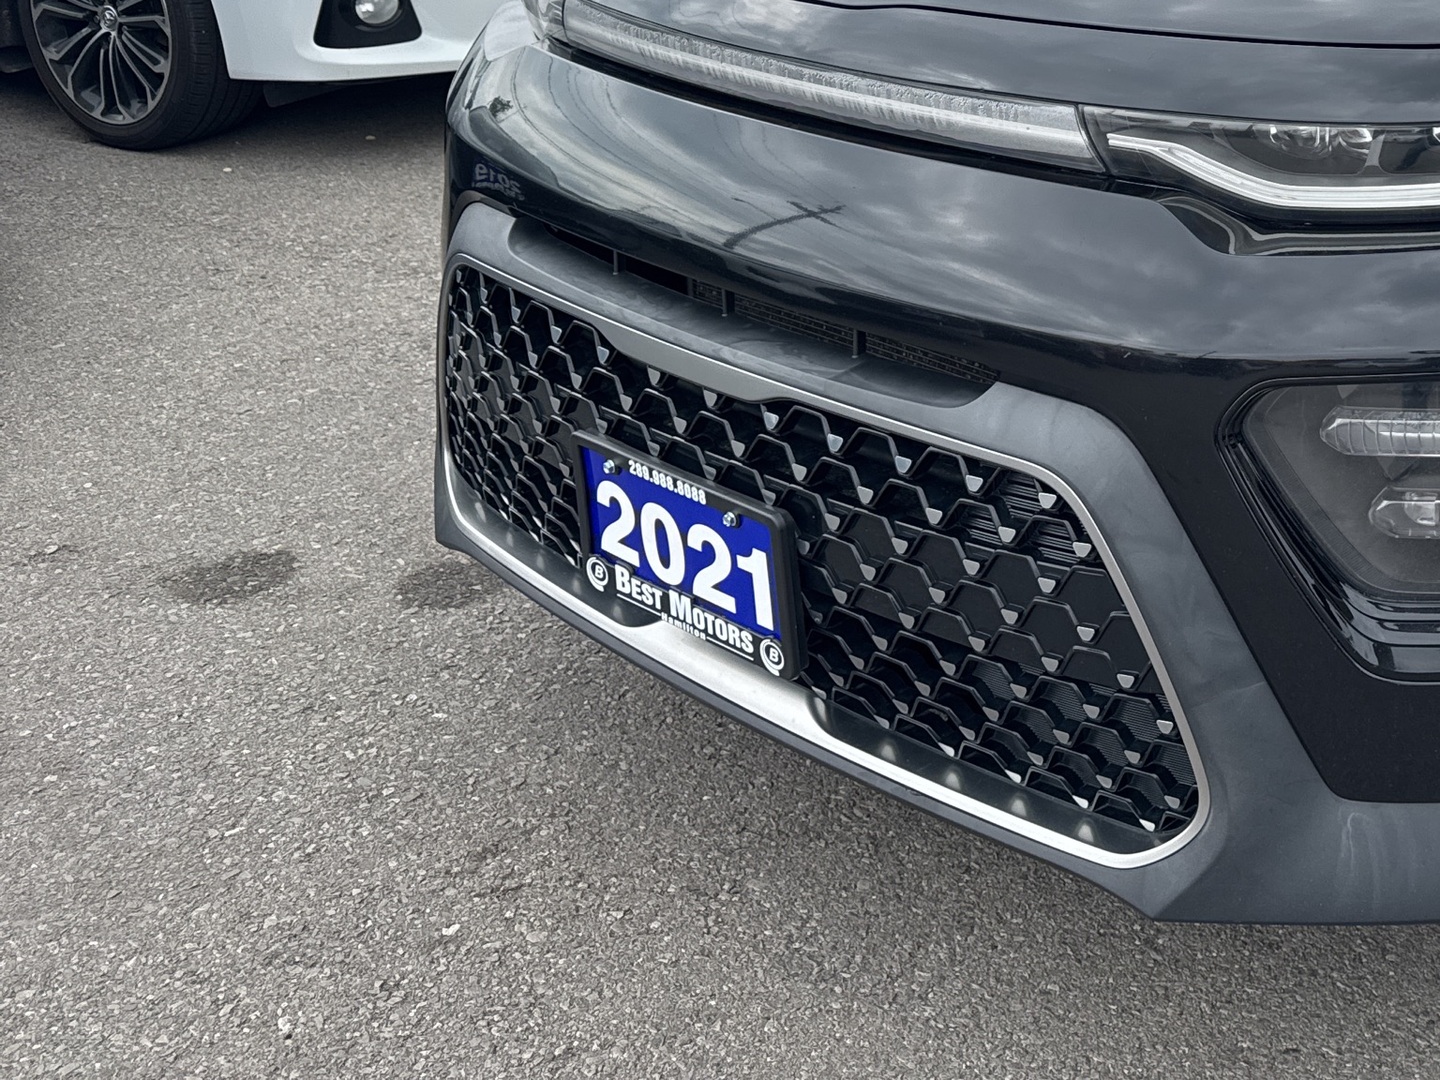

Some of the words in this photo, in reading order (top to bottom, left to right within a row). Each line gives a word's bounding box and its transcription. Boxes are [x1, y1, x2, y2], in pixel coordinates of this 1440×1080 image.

[628, 460, 707, 505] 289.988.8088
[596, 480, 774, 631] 2021
[614, 563, 663, 610] BEST
[668, 588, 754, 654] MOTORS
[661, 611, 707, 641] Hamilton
